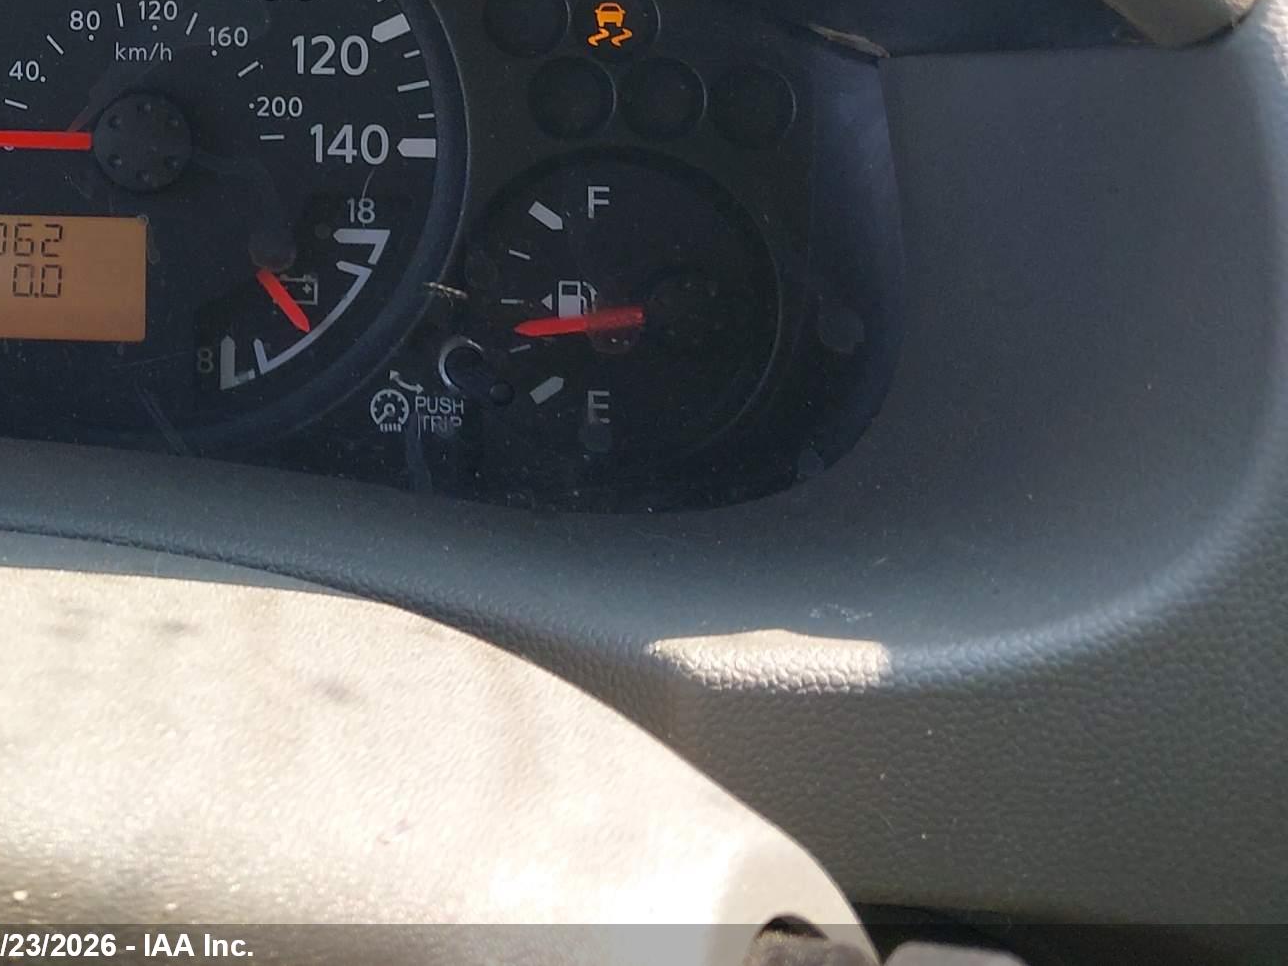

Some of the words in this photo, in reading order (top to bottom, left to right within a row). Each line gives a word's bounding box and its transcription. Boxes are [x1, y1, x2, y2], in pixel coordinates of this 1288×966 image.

[69, 10, 101, 31] 80
[138, 0, 178, 21] 120
[208, 26, 248, 47] 160
[115, 41, 172, 61] km/h
[292, 35, 369, 76] 120
[8, 60, 40, 81] 40
[257, 96, 303, 117] 200
[310, 123, 389, 165] 140
[347, 197, 376, 224] 18
[587, 185, 610, 219] F
[12, 263, 63, 299] 0.0
[414, 395, 464, 415] PUSH
[587, 390, 611, 424] E
[422, 415, 462, 433] TRIP
